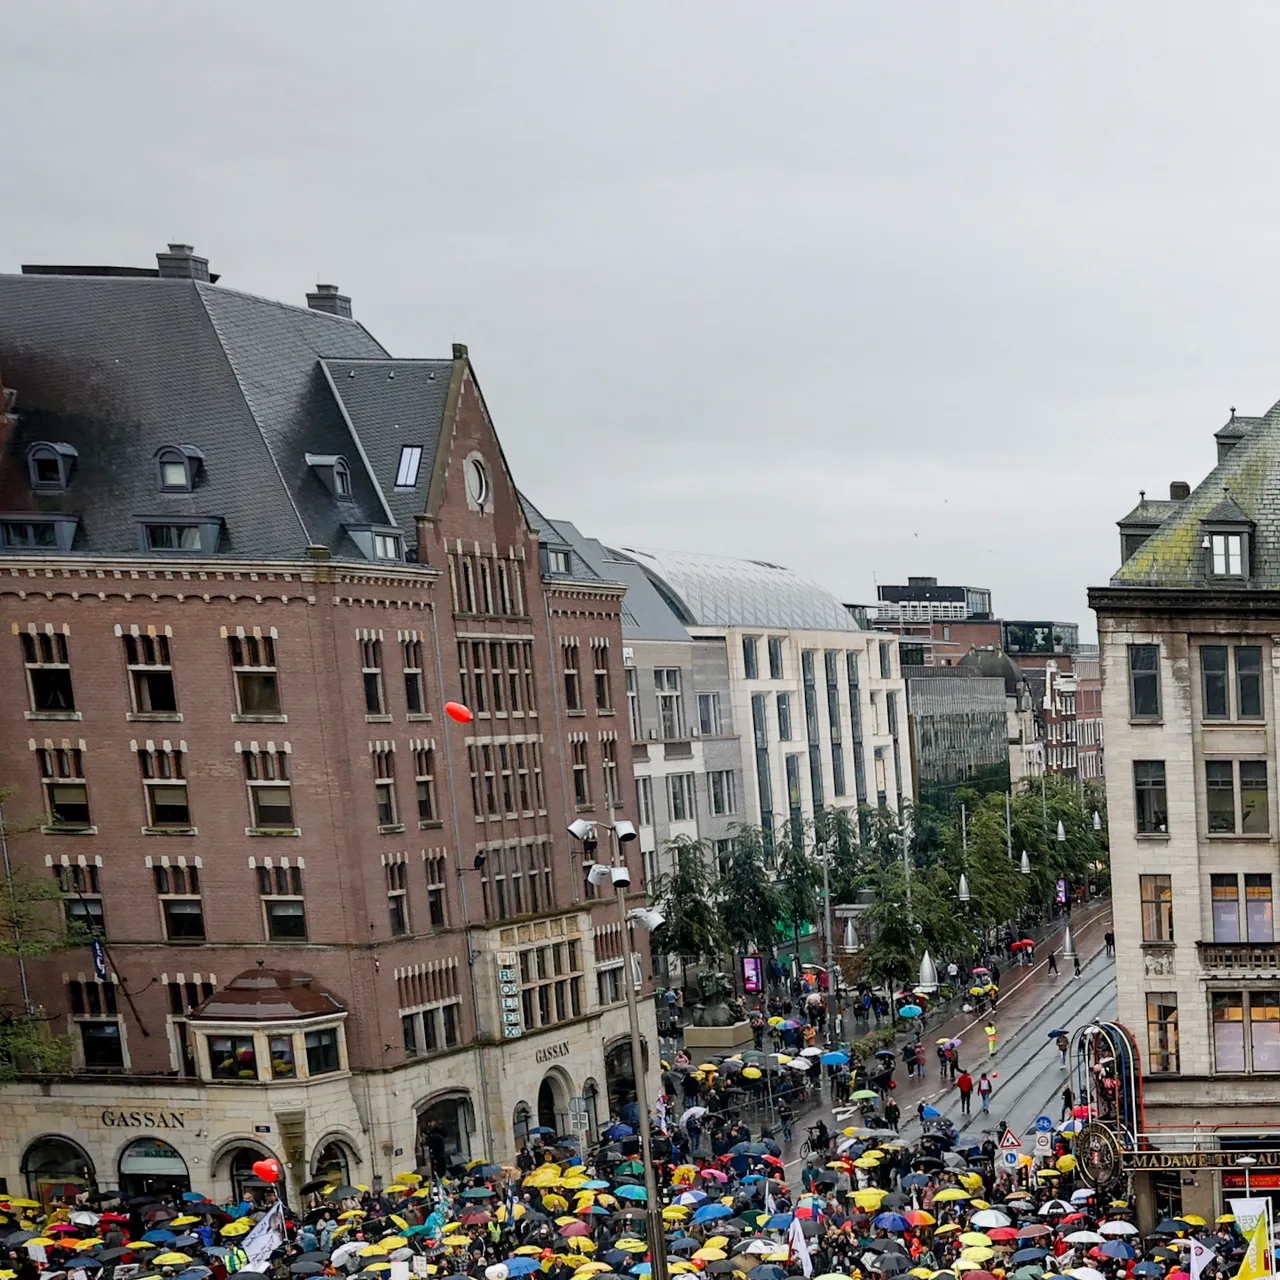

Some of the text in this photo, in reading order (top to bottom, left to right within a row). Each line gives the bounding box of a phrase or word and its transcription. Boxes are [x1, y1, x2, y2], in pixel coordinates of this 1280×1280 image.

[535, 1041, 570, 1064] GASSAN
[101, 1111, 186, 1129] GASSAN
[1132, 1152, 1209, 1168] MADAME
